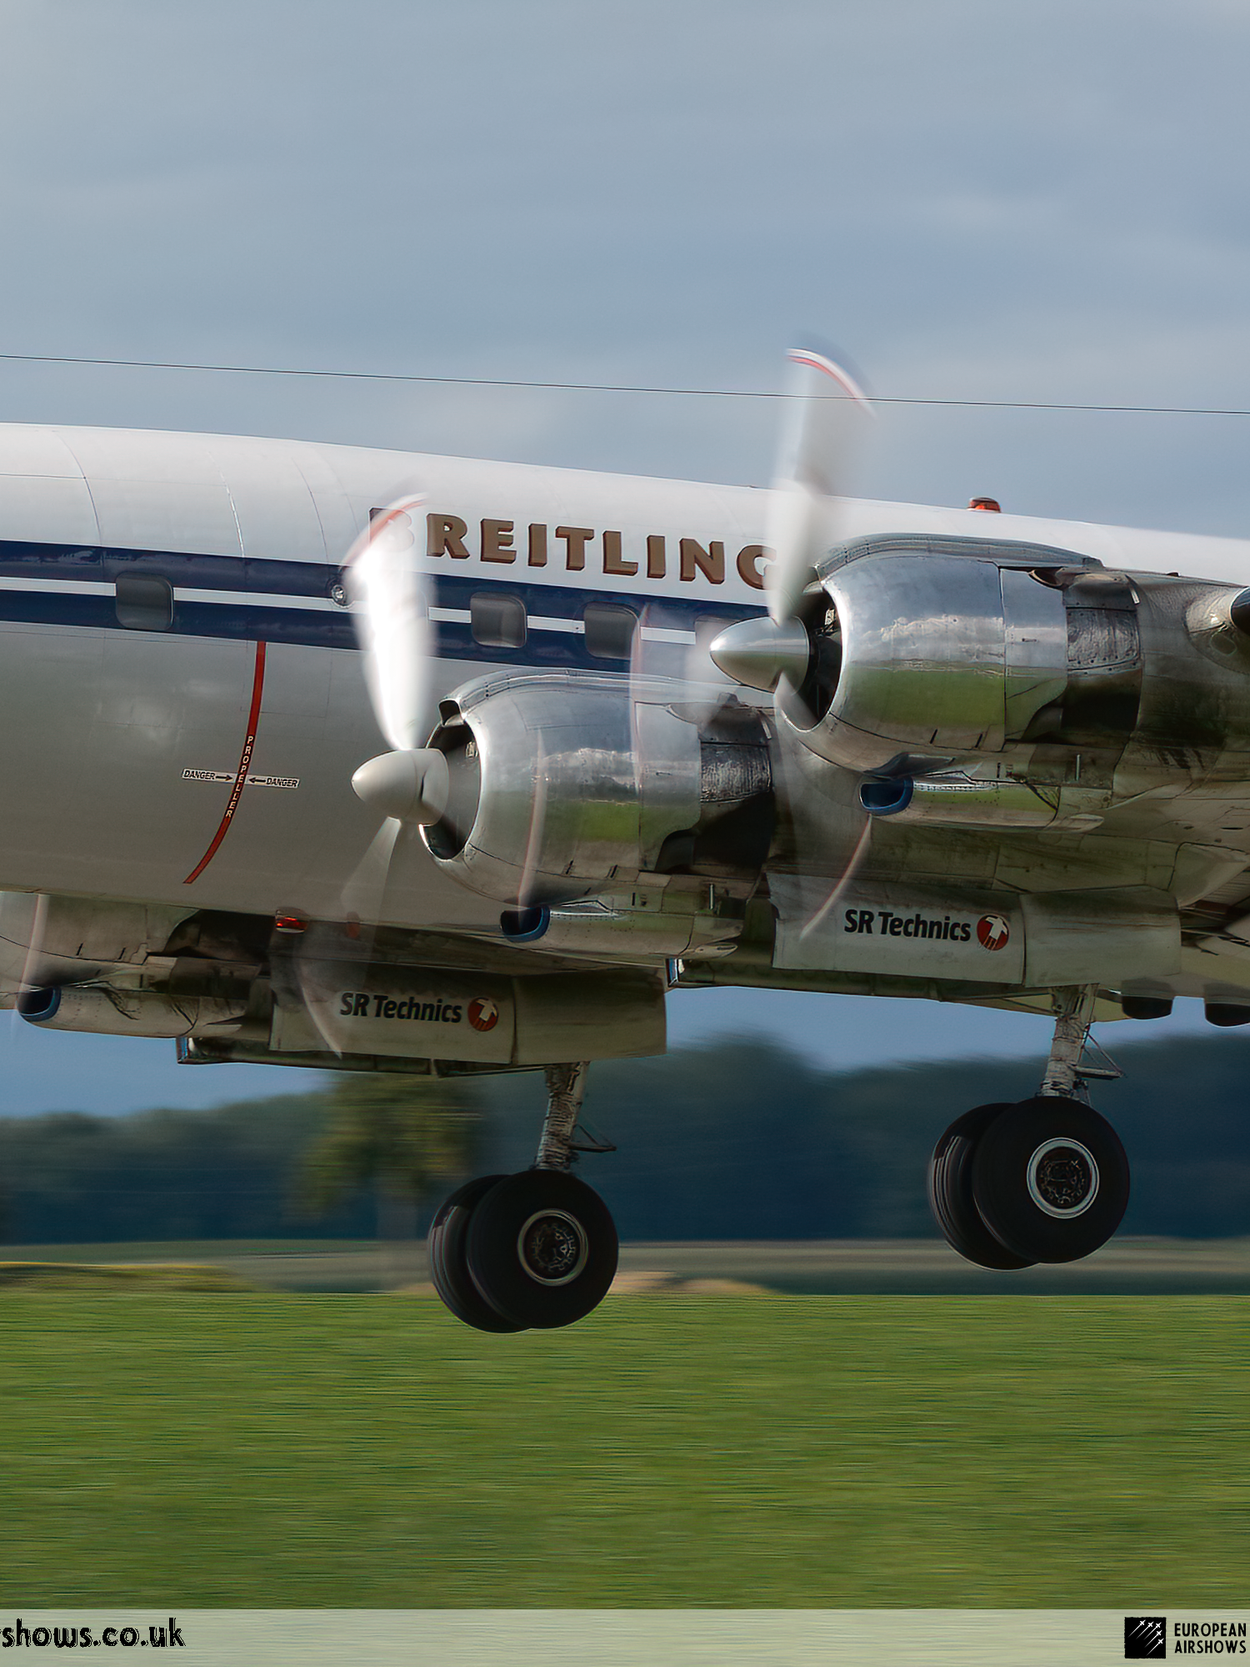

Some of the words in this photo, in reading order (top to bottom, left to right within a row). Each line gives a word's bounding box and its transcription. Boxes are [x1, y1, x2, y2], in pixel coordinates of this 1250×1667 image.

[184, 769, 216, 780] DANGER
[225, 735, 254, 818] PROPELLER
[266, 777, 298, 787] DANGER
[844, 909, 874, 934] SR
[878, 912, 971, 942] Technics
[340, 992, 370, 1017] SR
[373, 994, 462, 1023] Technics
